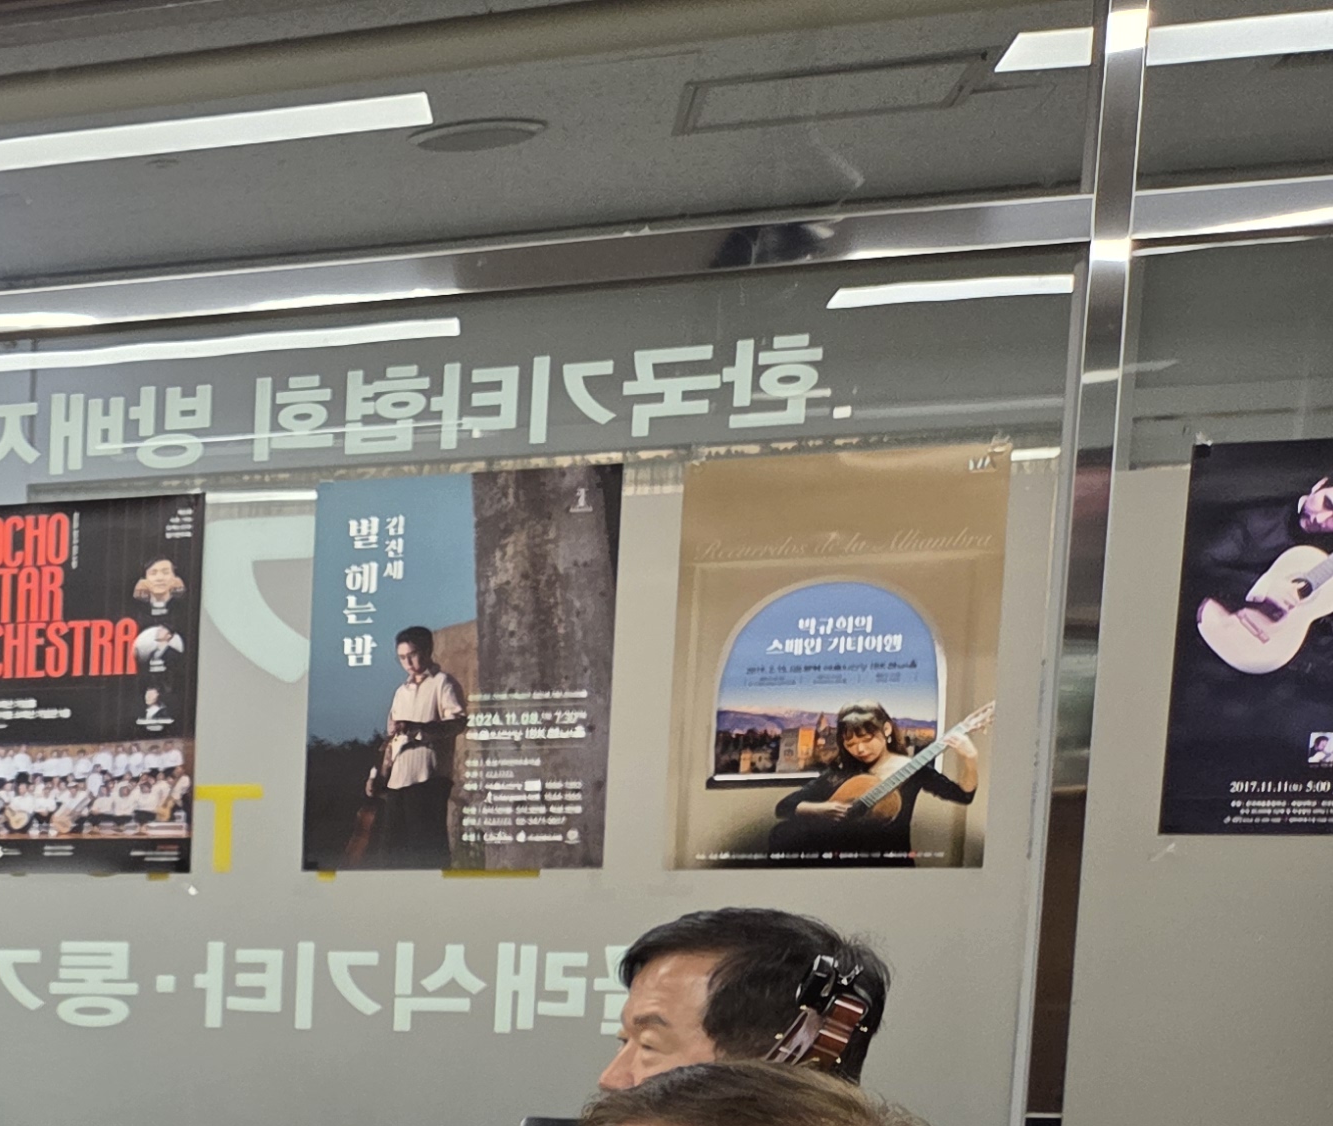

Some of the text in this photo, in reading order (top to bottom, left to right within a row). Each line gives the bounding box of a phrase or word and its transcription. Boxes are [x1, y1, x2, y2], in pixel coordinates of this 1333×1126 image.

[342, 516, 380, 667] 별 헤는 밤
[766, 637, 821, 656] 스페인
